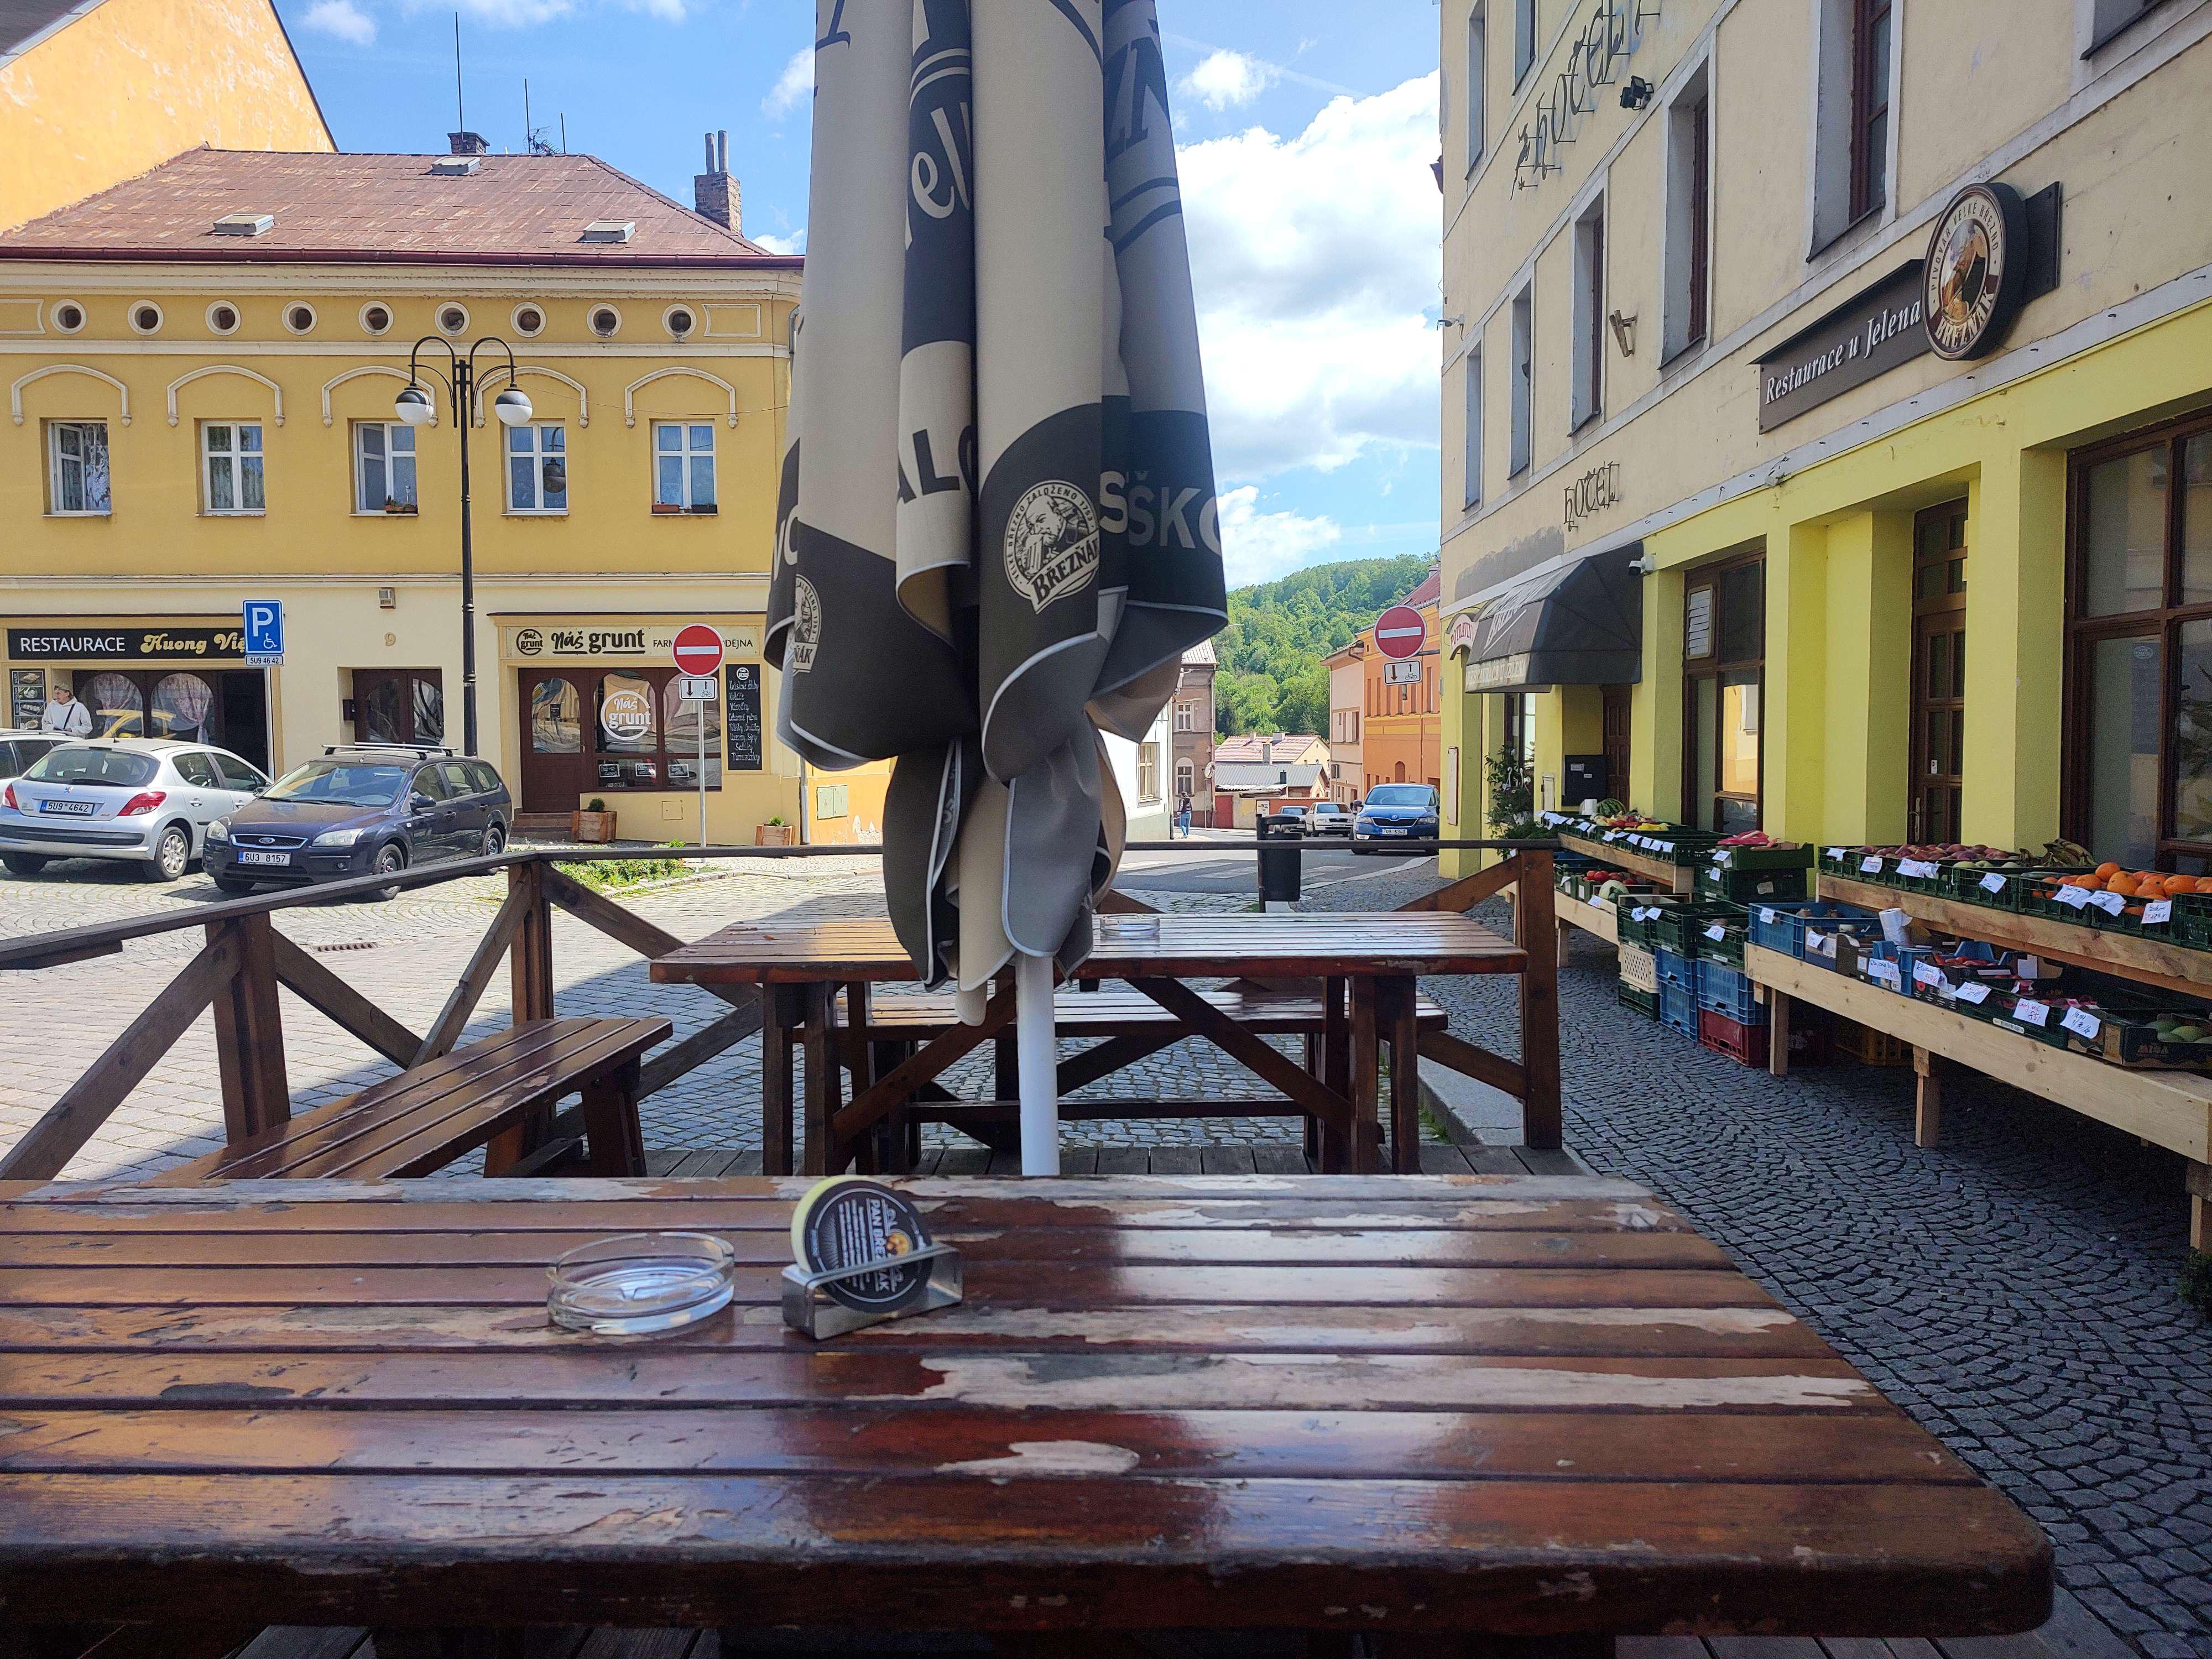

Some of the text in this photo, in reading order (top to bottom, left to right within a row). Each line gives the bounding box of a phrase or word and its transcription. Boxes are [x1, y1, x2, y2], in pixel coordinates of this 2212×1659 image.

[1931, 200, 1999, 291] PIVOVAR VELKÉ BŘEZNO
[1766, 300, 1921, 404] Restaurace u Jelena
[252, 608, 273, 637] P
[20, 637, 125, 651] RESTAURACE
[140, 633, 207, 654] Huong
[520, 639, 543, 649] grunt
[551, 629, 645, 654] Náš grunt
[614, 697, 638, 711] Náš
[608, 711, 651, 729] grunt
[48, 802, 88, 812] 5U9 4642
[266, 854, 286, 863] 8157
